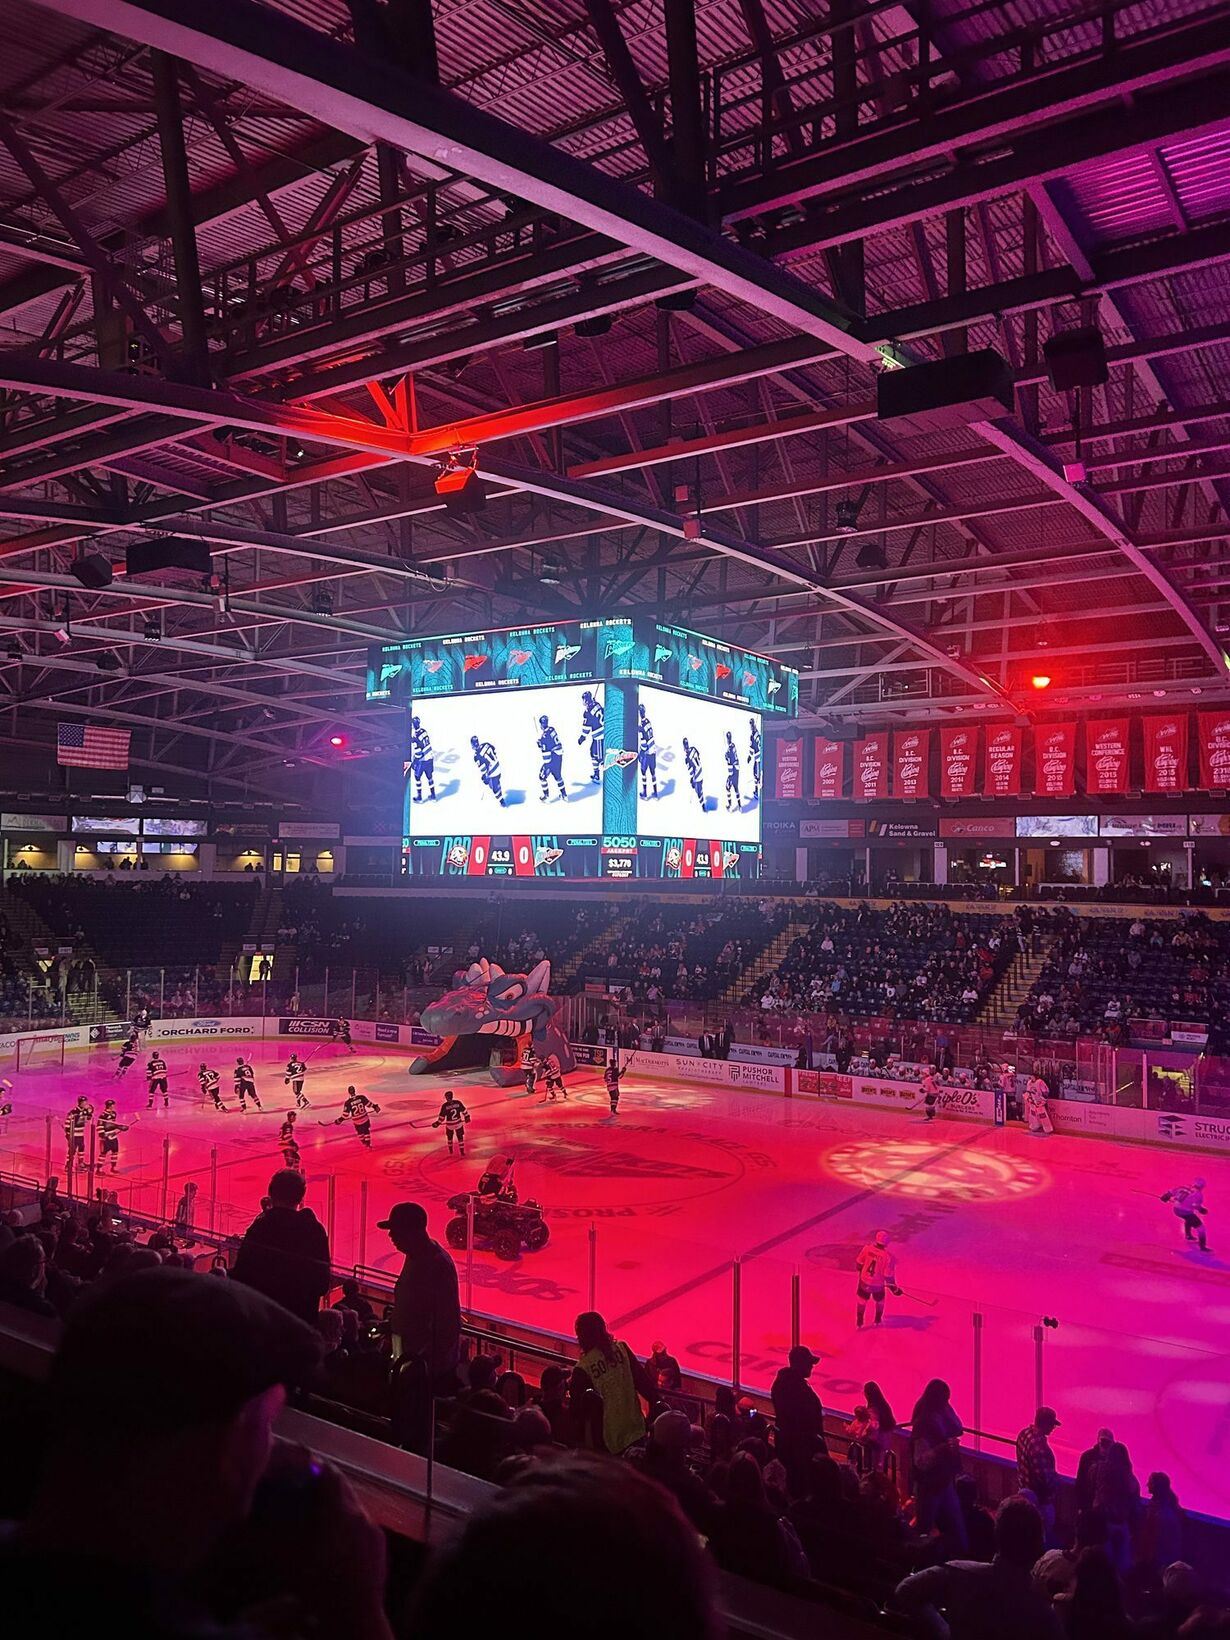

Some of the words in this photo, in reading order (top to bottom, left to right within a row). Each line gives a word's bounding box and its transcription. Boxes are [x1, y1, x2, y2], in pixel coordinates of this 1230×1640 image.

[967, 824, 995, 832] Canco
[603, 836, 636, 848] 5050
[475, 846, 484, 864] 0
[491, 850, 510, 861] 43.9
[519, 846, 529, 864] 0
[685, 849, 692, 867] 0
[714, 850, 720, 867] 0
[162, 1028, 218, 1036] ORCHARD
[676, 1058, 695, 1067] SUN
[702, 1062, 724, 1070] CITY
[742, 1066, 773, 1075] PUSHOR
[743, 1073, 779, 1083] MITCHELL
[352, 1104, 364, 1116] 28
[450, 1109, 457, 1121] 2
[1052, 1112, 1082, 1122] Thornton
[868, 1260, 876, 1277] 4
[591, 1360, 607, 1378] 50
